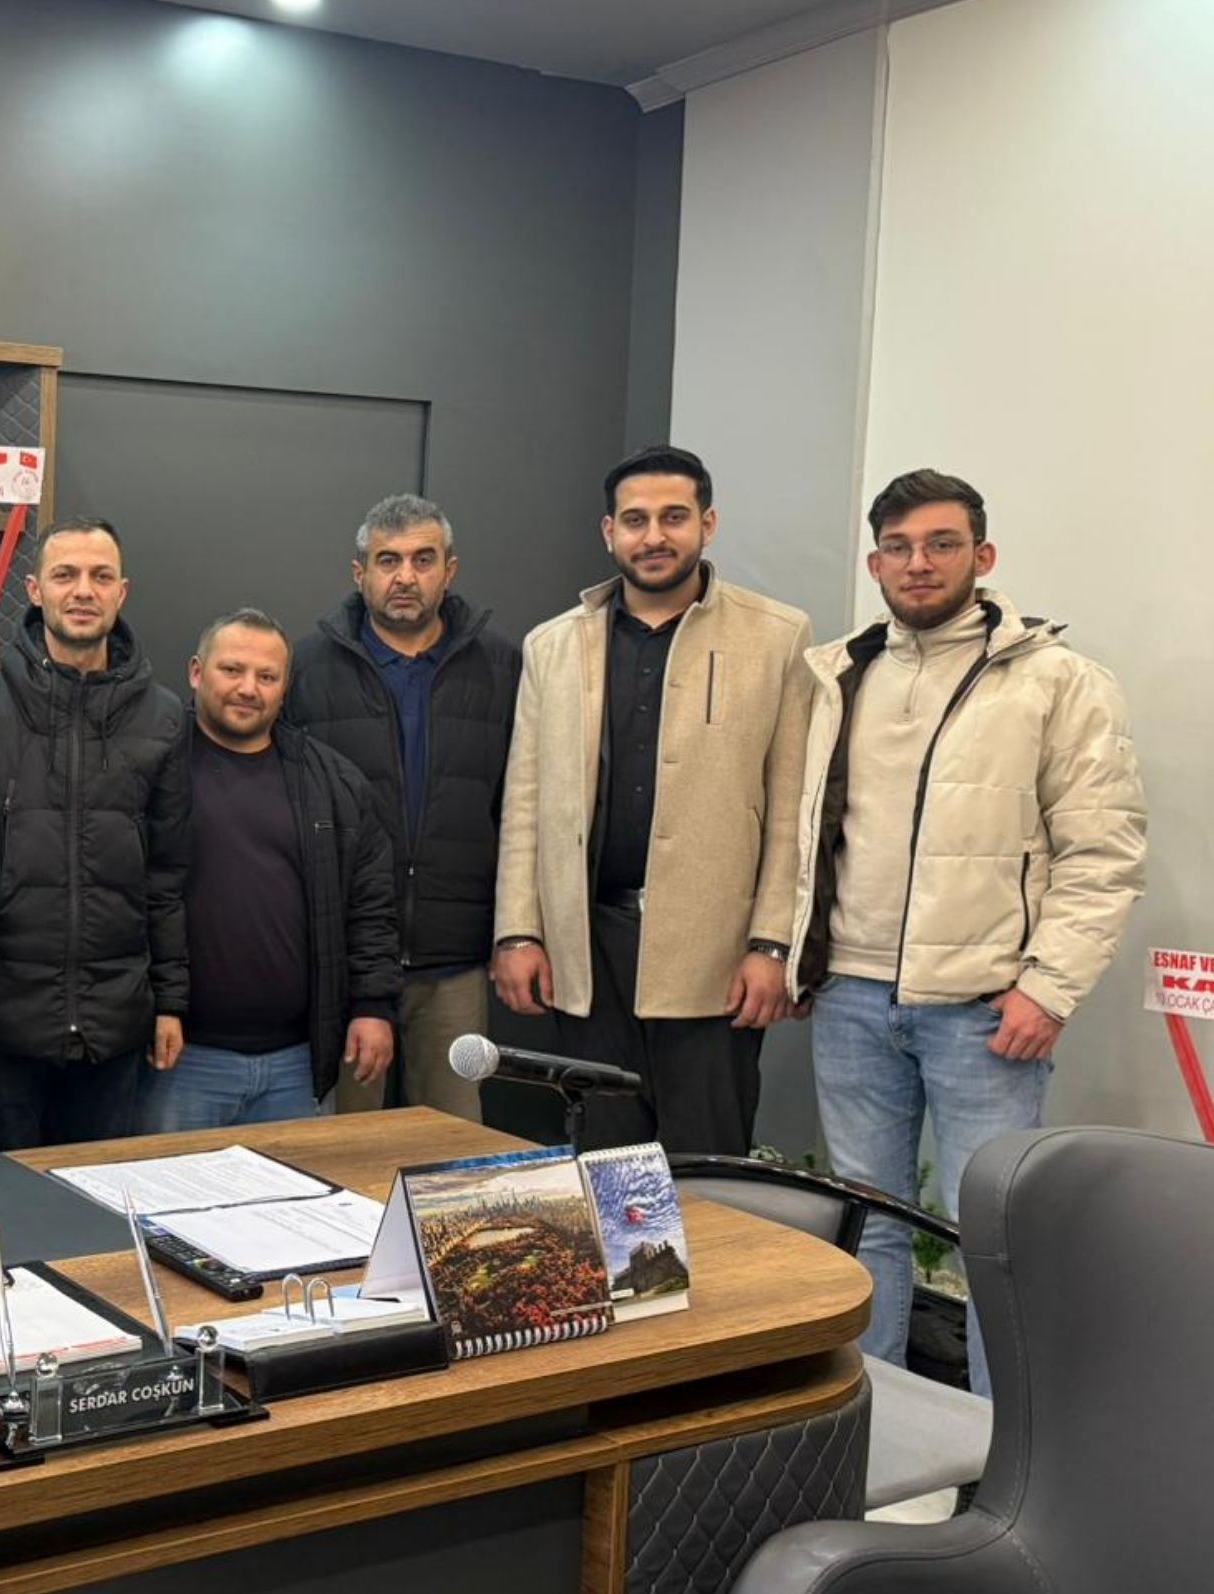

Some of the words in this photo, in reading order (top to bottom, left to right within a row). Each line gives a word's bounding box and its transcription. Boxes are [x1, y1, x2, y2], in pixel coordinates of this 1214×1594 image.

[1154, 951, 1196, 970] ESNAF
[1163, 974, 1214, 993] KA
[69, 1391, 128, 1414] SERDAR
[131, 1378, 194, 1401] COŞKUN
